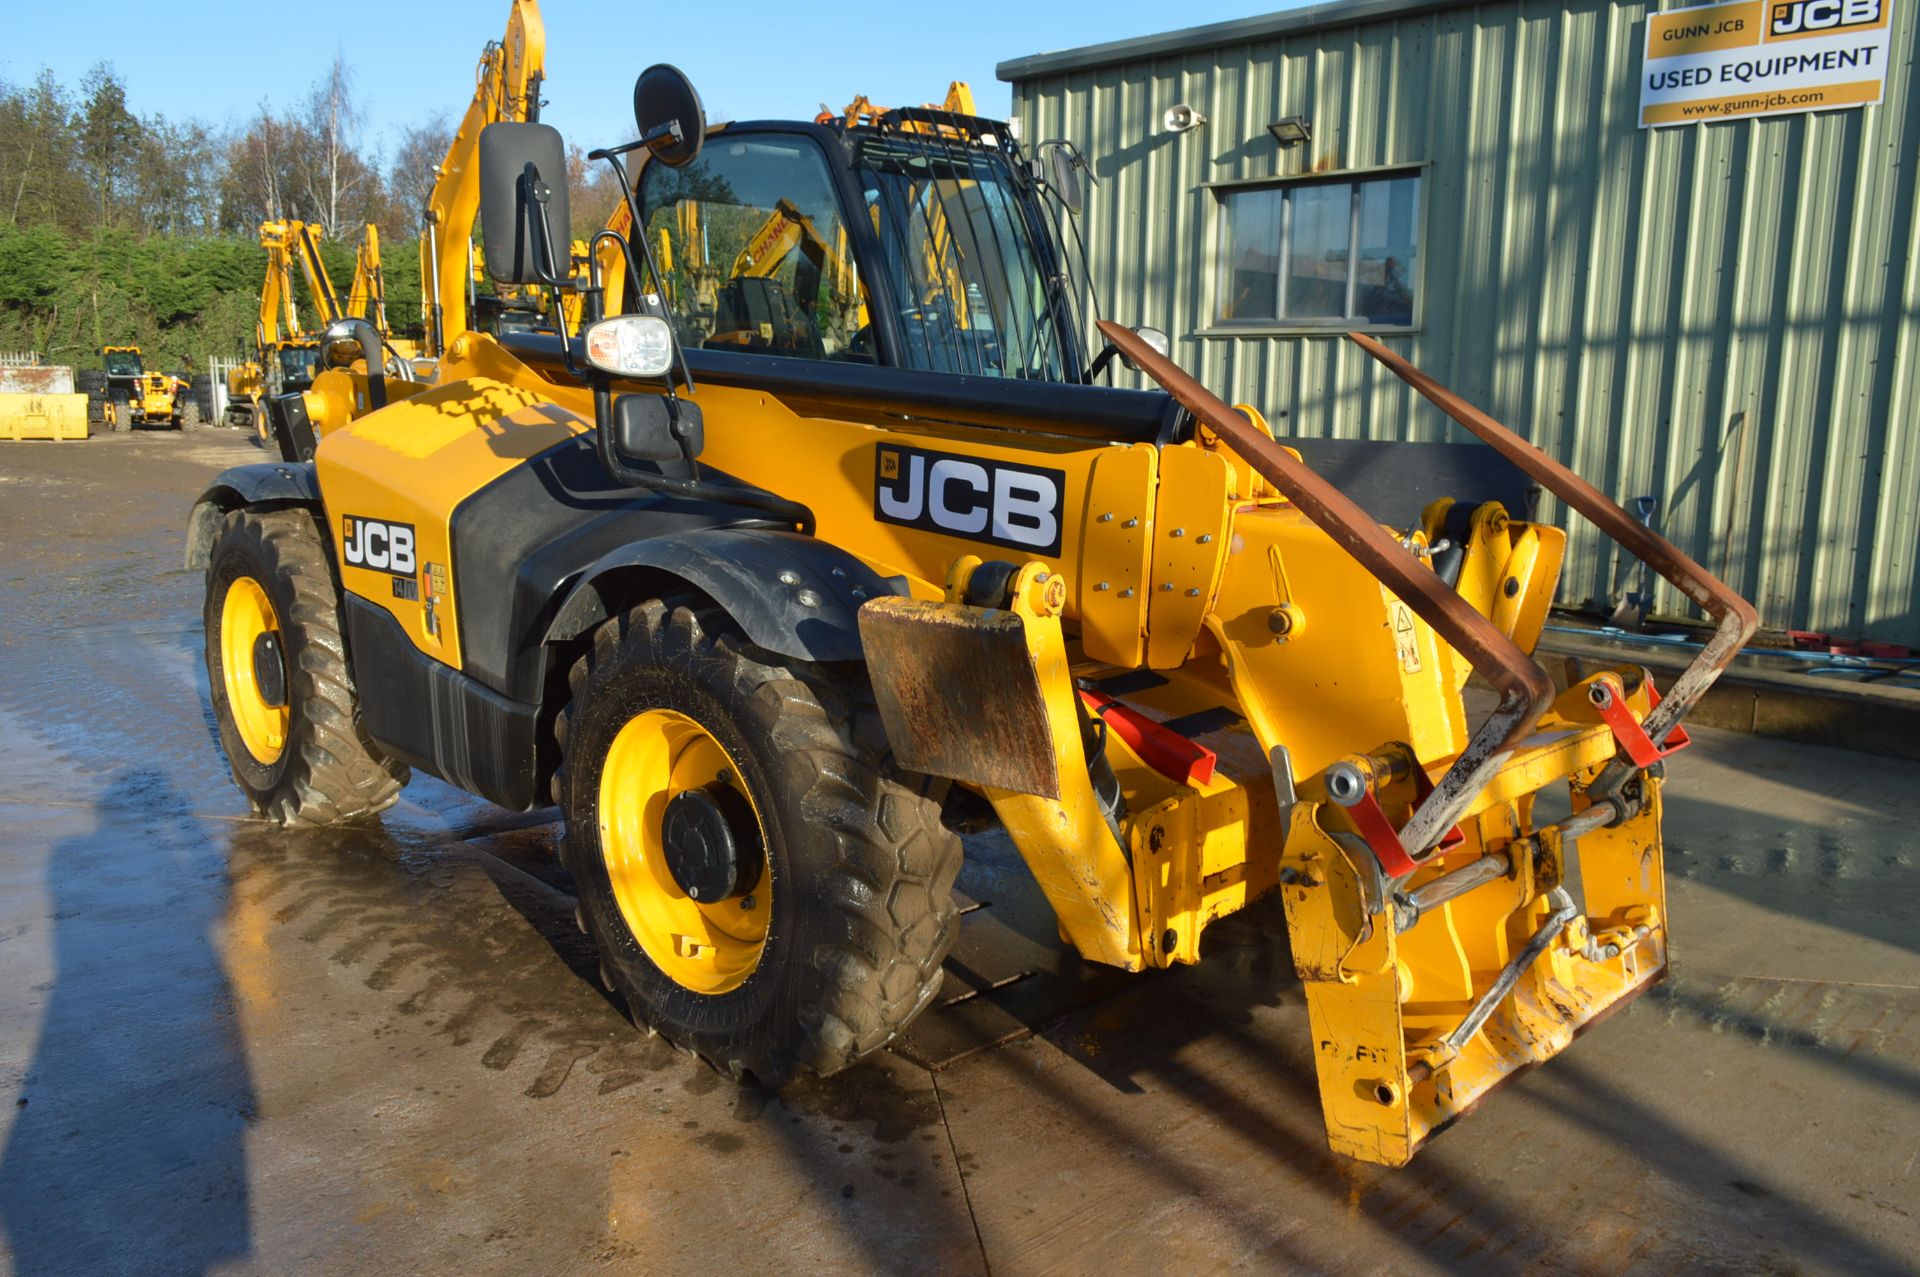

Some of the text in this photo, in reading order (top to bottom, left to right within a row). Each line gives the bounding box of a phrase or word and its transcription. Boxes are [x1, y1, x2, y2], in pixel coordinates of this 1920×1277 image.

[1663, 19, 1744, 41] GUNN JCB
[1774, 0, 1879, 33] JCB
[1649, 46, 1879, 91] USED EQUIPMENT
[1682, 91, 1824, 115] www.gunn-jcb.com
[879, 454, 1057, 548] JCB
[345, 520, 415, 574] JCB
